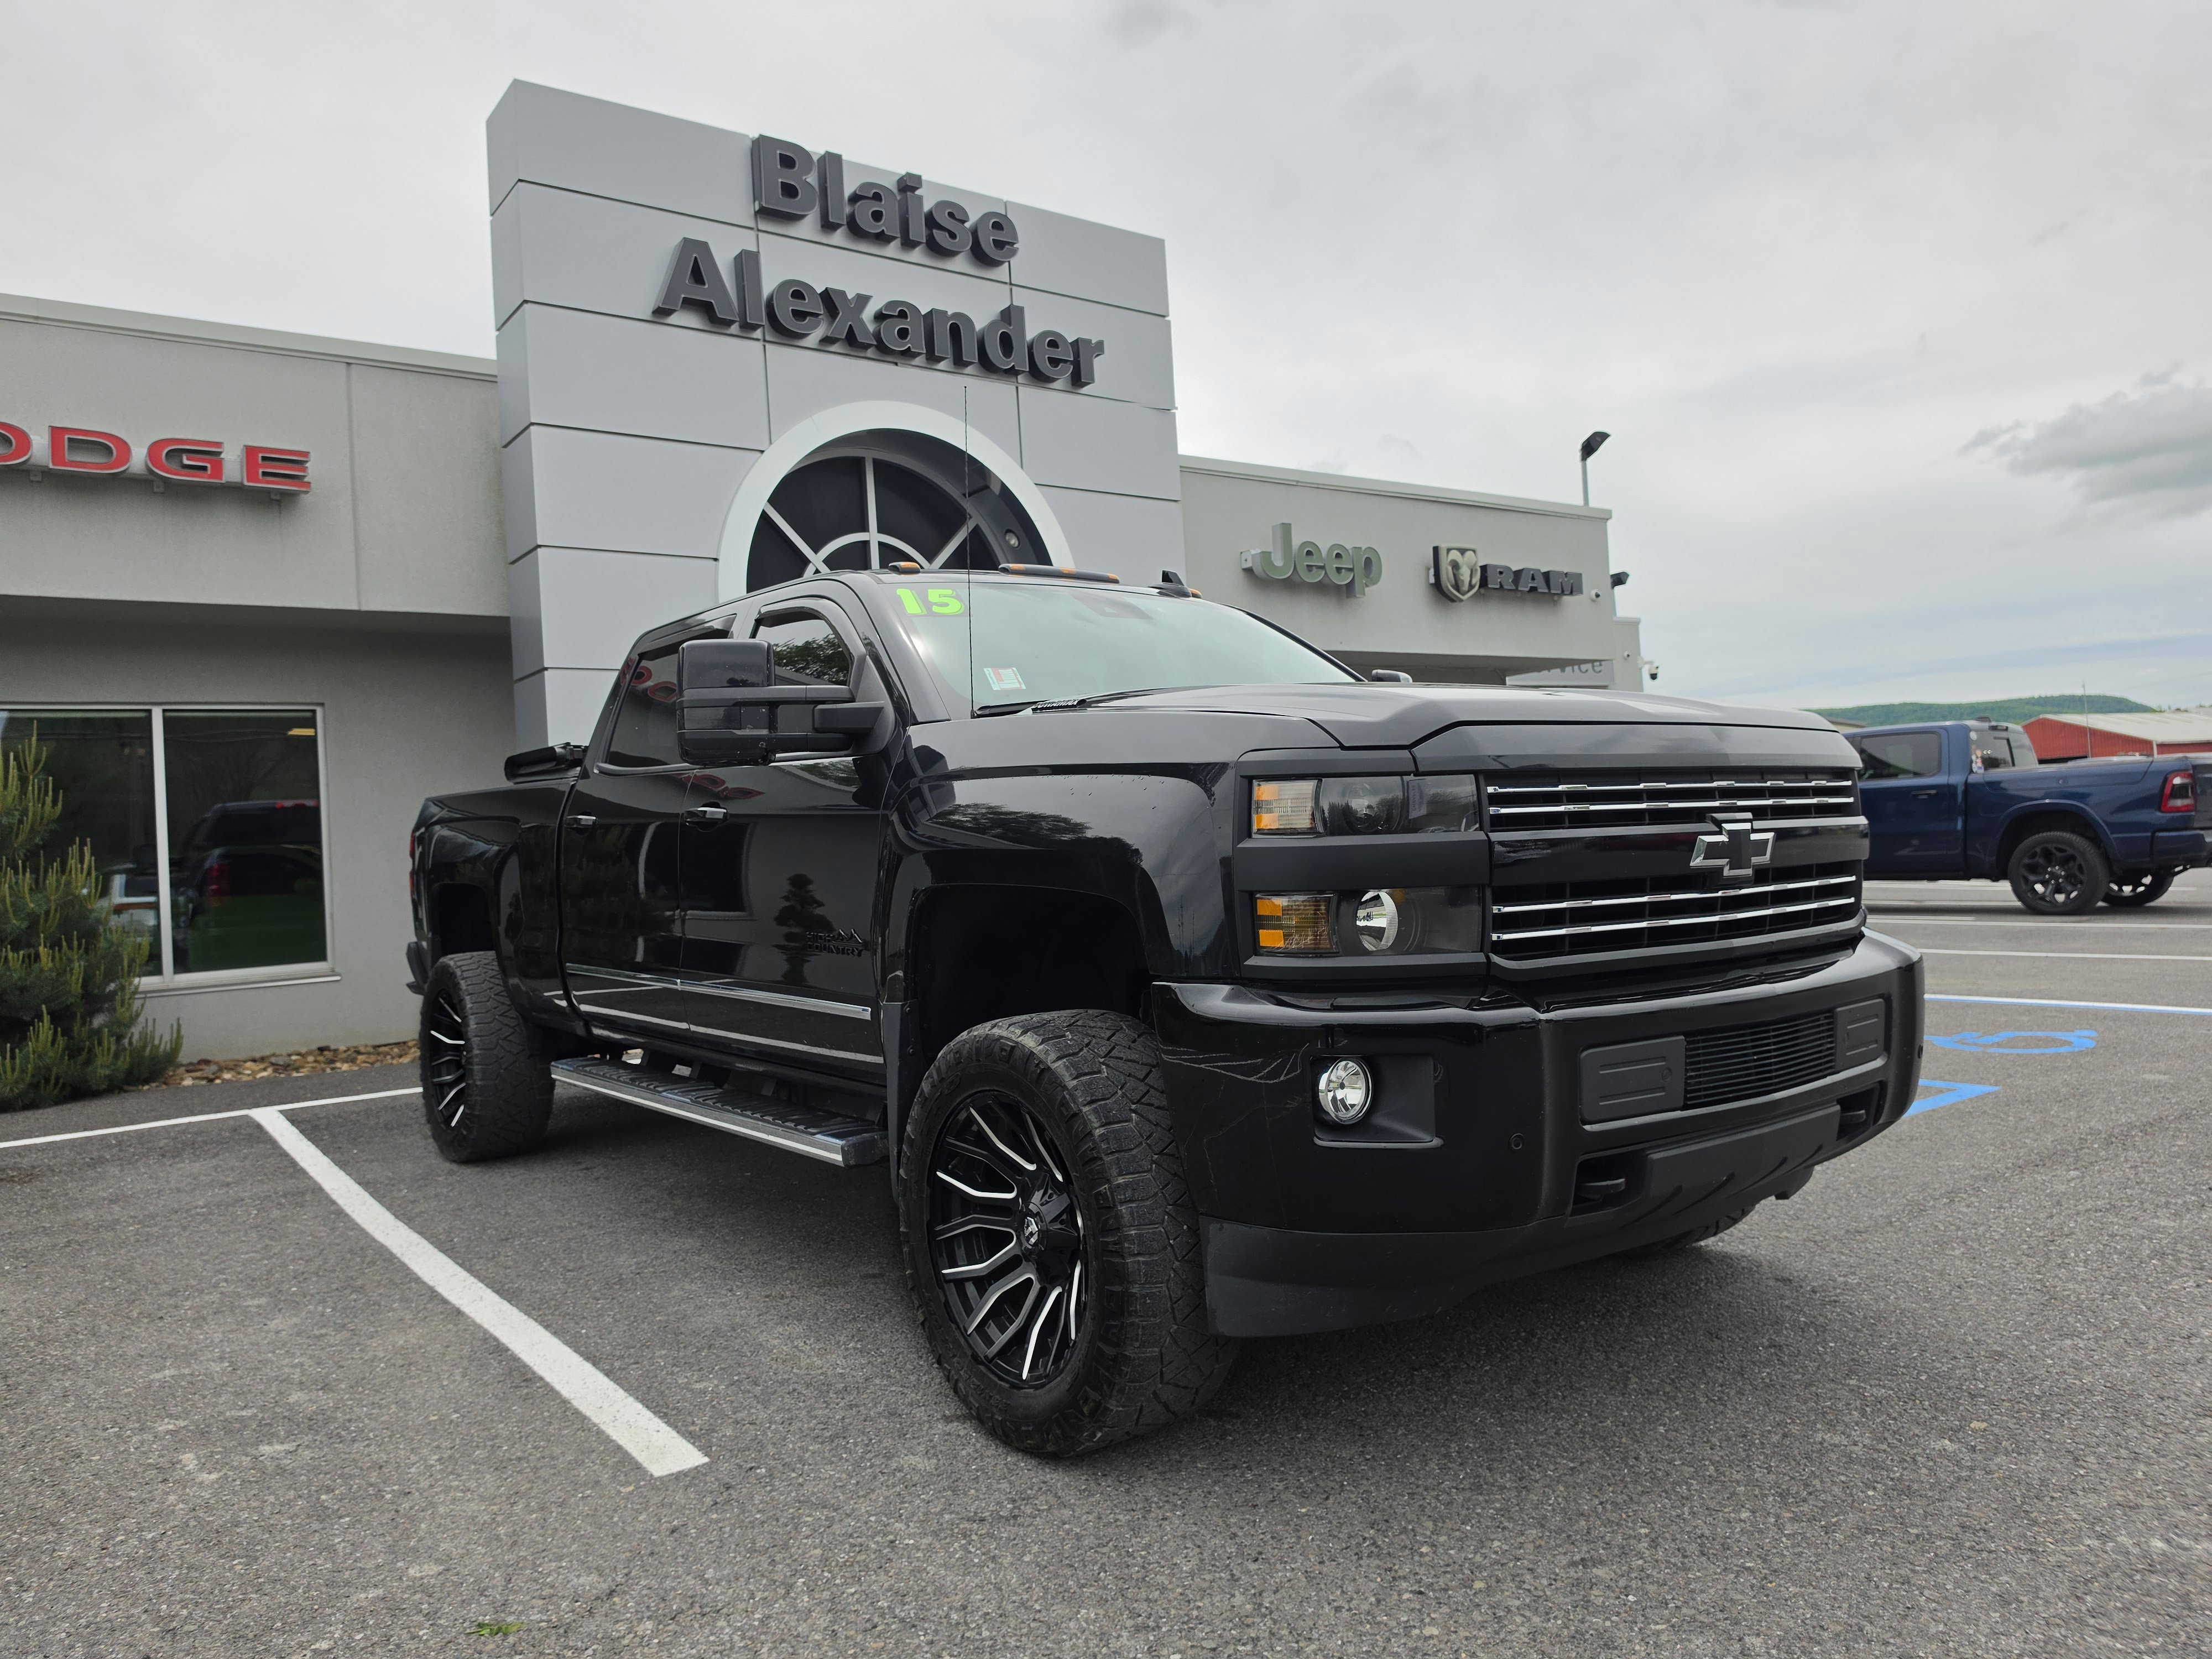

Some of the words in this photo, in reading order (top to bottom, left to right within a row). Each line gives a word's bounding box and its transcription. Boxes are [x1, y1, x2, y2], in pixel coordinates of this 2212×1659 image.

[752, 134, 1019, 267] Blaise
[653, 237, 1105, 388] Alexander
[1249, 523, 1383, 598] Jeep
[1481, 563, 1583, 596] RAM
[896, 588, 965, 615] 15
[807, 942, 864, 957] COUNTRY
